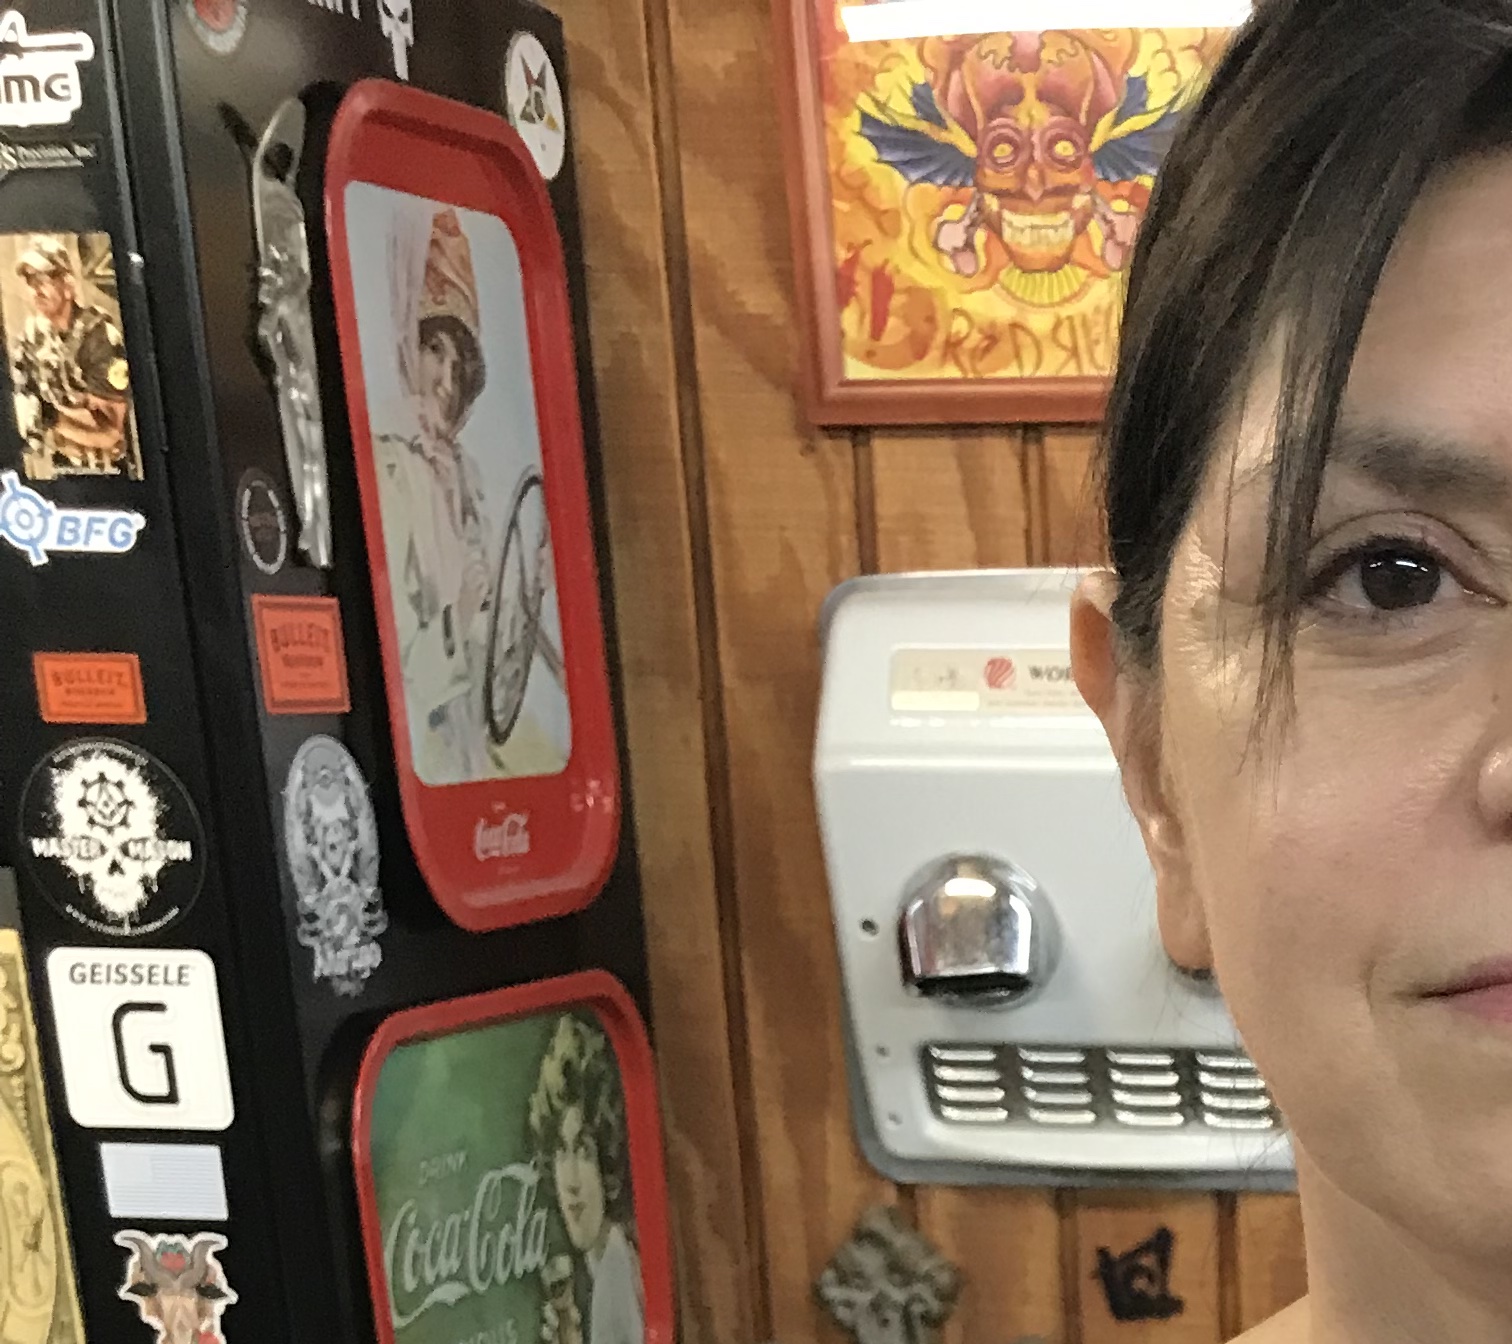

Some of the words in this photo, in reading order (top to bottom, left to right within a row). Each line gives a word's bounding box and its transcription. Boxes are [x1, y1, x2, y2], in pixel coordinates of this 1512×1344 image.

[56, 514, 134, 548] BFG
[68, 961, 191, 987] GEISSELE
[112, 1001, 181, 1105] G
